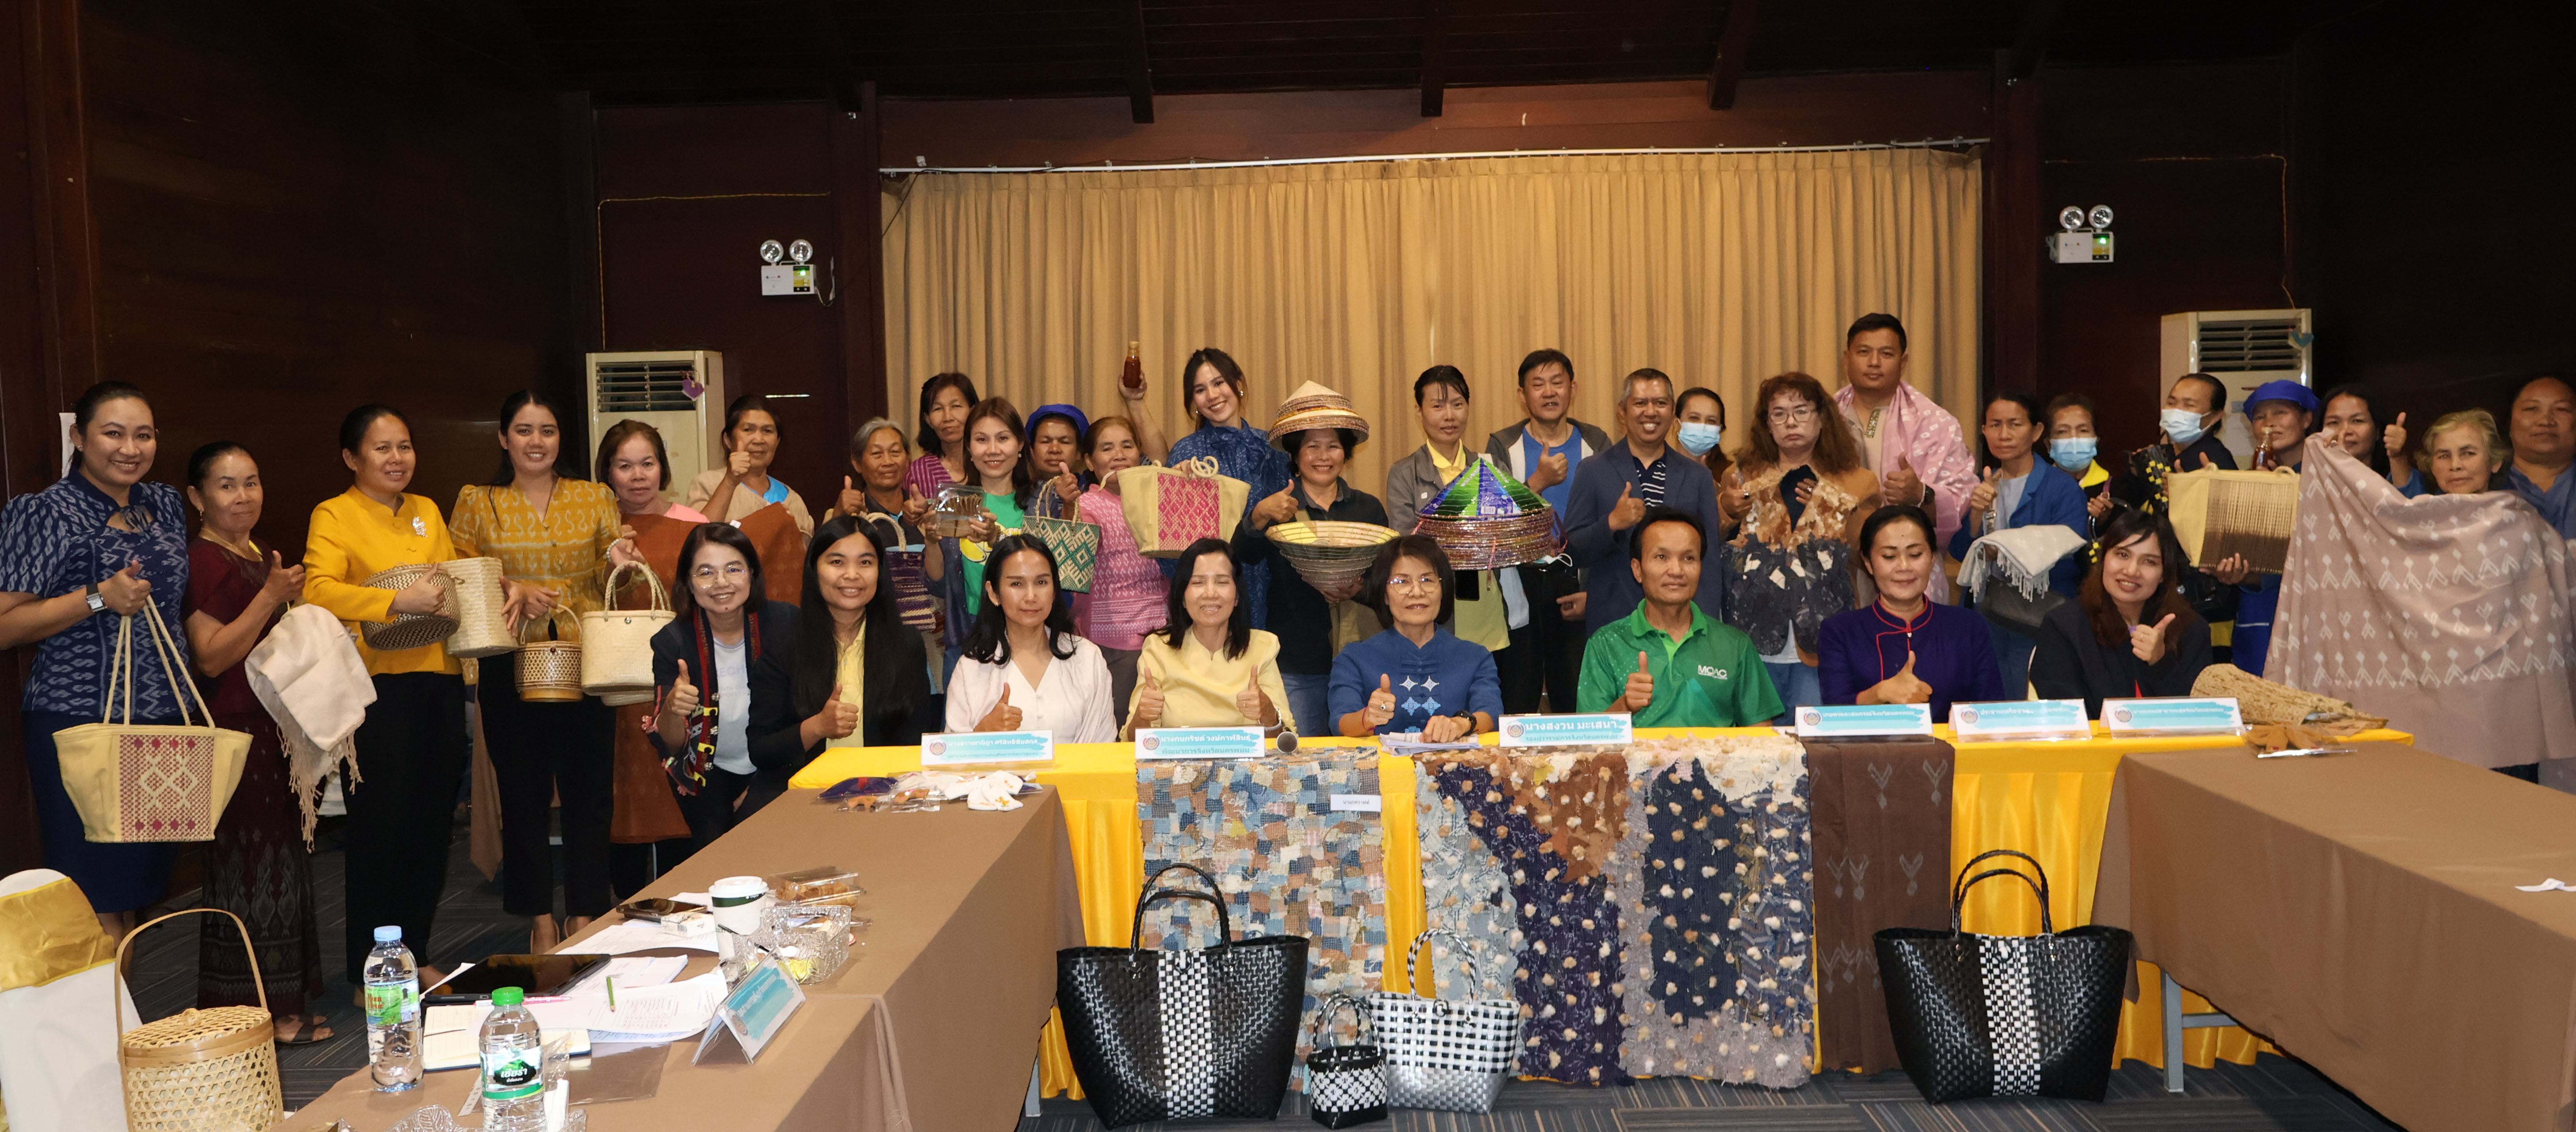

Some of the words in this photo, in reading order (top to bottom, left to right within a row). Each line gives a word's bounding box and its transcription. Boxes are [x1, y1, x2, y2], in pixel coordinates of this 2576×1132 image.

[1698, 665, 1727, 678] MOAC
[1525, 722, 1574, 731] นางสงวน
[1577, 721, 1618, 729] มะเสนา
